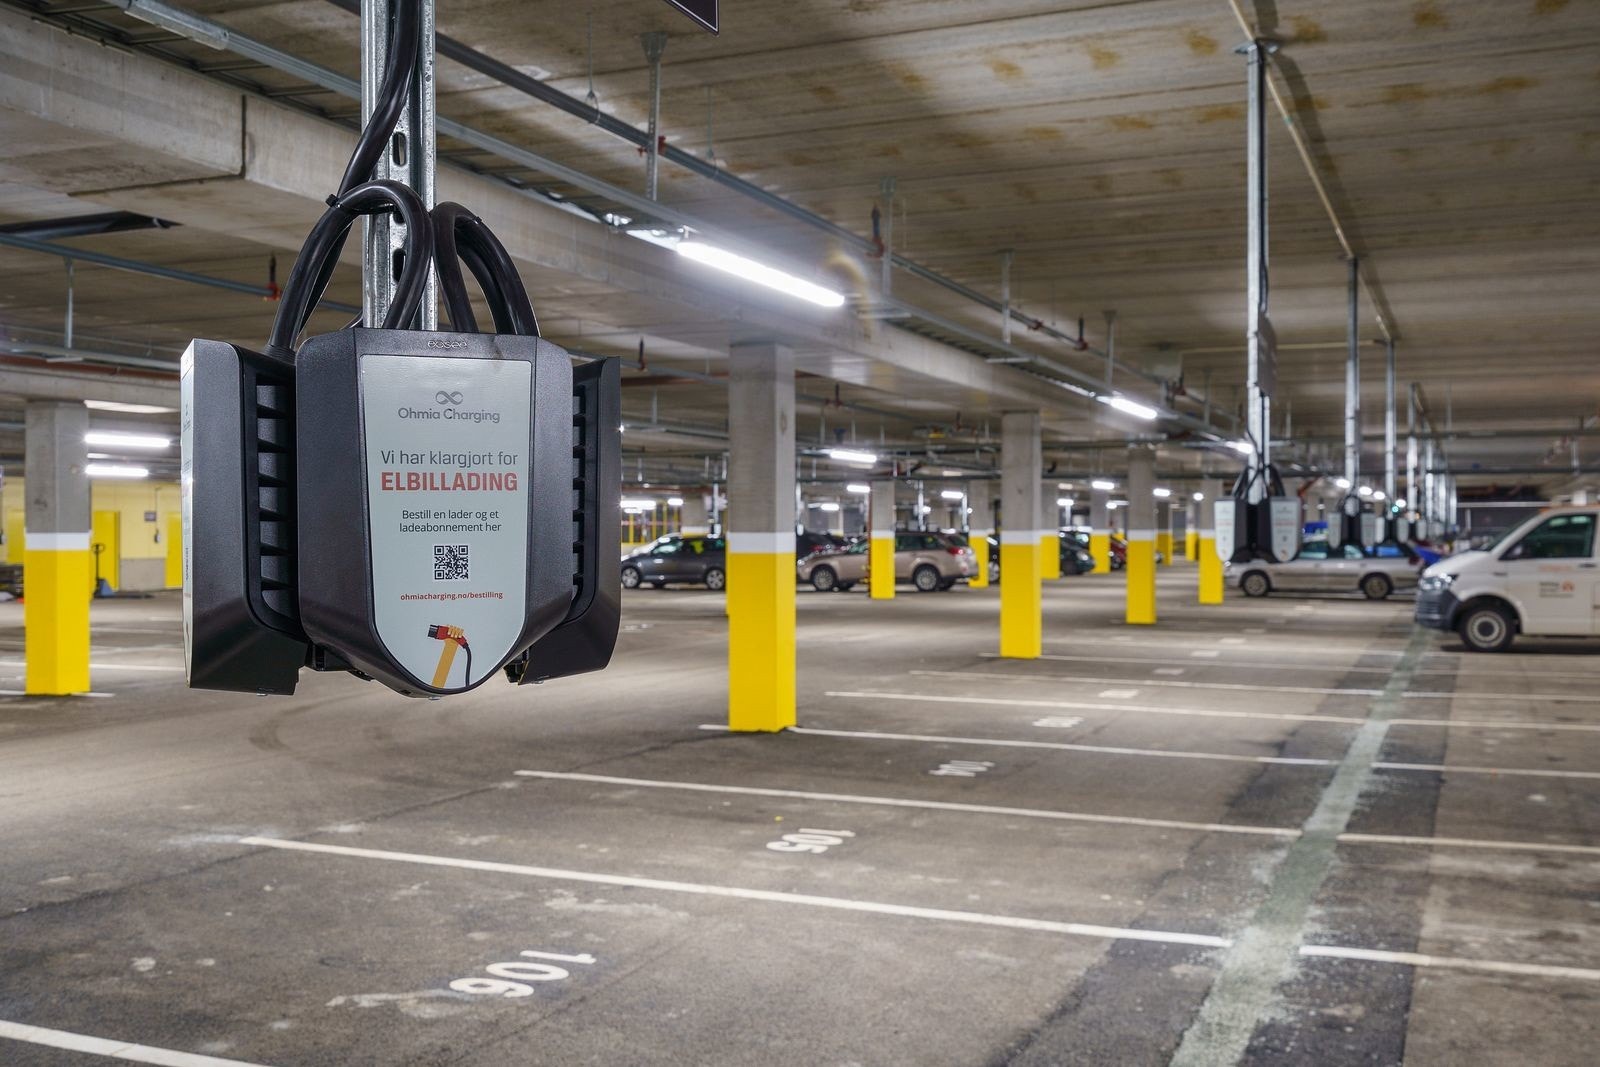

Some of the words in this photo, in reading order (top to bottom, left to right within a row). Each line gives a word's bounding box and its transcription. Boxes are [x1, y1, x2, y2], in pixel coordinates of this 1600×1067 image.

[398, 407, 441, 420] Ohmia
[443, 407, 501, 424] Charging
[381, 450, 395, 465] Vi
[400, 450, 426, 465] har
[429, 451, 494, 468] klargjort
[498, 451, 518, 466] for
[381, 471, 518, 491] ELBILLADING
[402, 509, 431, 520] Bestill
[433, 511, 446, 519] en
[448, 509, 473, 520] lader
[475, 511, 488, 521] og
[489, 510, 499, 519] et
[399, 522, 484, 532] ladeabonnement
[485, 522, 502, 532] her
[400, 591, 503, 601] ohmiacharging.no/bestilling
[766, 828, 856, 853] 105
[450, 950, 596, 998] 106
